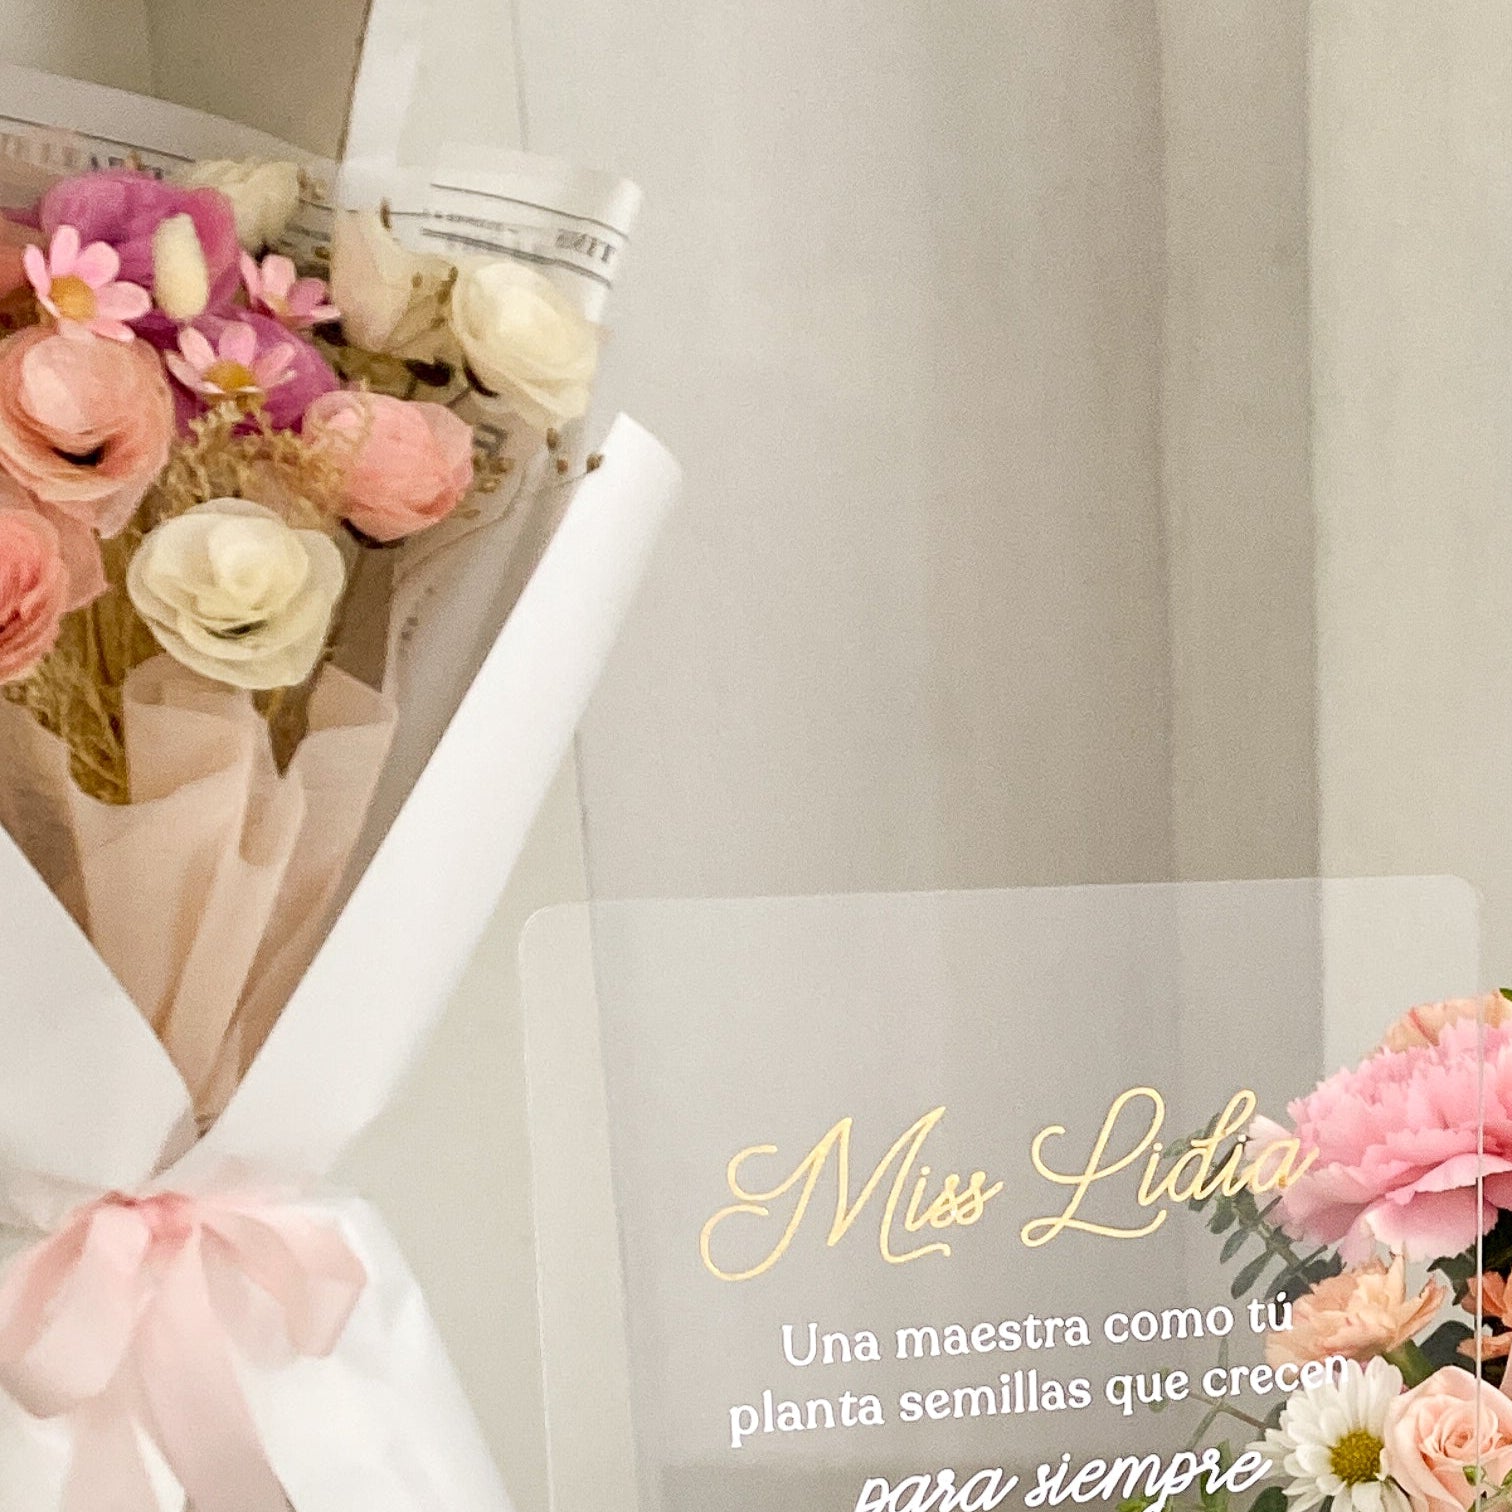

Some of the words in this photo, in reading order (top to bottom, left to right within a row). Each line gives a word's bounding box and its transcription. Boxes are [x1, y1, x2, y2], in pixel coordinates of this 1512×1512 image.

[699, 1106, 1004, 1281] Miss
[1020, 1086, 1320, 1248] Lidia
[781, 1321, 881, 1367] Una
[895, 1312, 1091, 1360] maestra
[1104, 1301, 1235, 1345] como
[1246, 1290, 1295, 1334] tú
[728, 1387, 885, 1448] planta
[898, 1370, 1092, 1424] semillas
[1104, 1367, 1190, 1419] que
[1201, 1352, 1352, 1399] crecen
